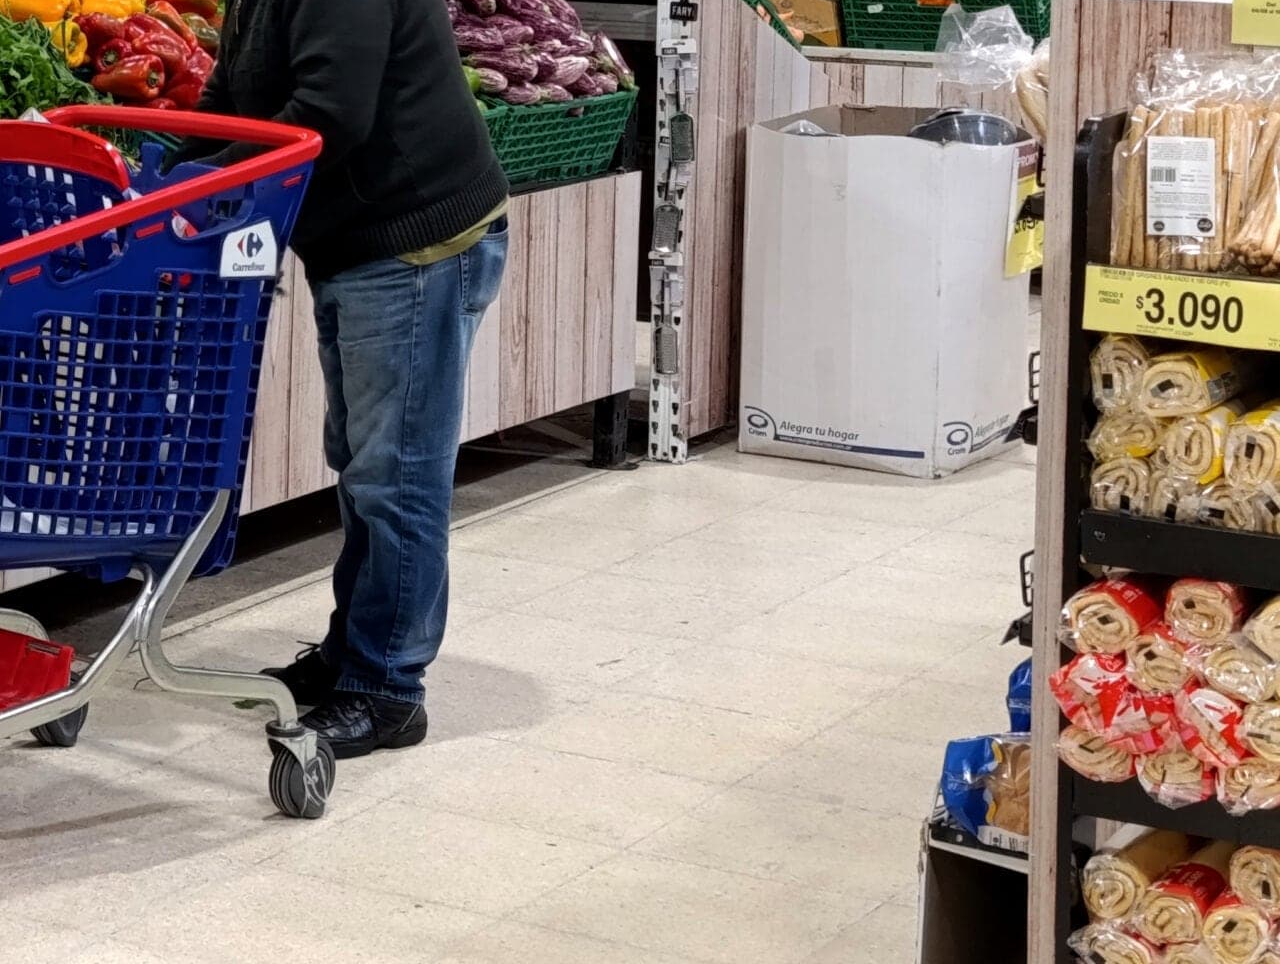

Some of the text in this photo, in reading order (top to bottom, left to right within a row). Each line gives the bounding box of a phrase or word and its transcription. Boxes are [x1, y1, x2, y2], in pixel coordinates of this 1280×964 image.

[671, 5, 693, 17] FARY
[232, 262, 265, 272] Carrefour
[780, 421, 860, 442] Alegra tu hogar
